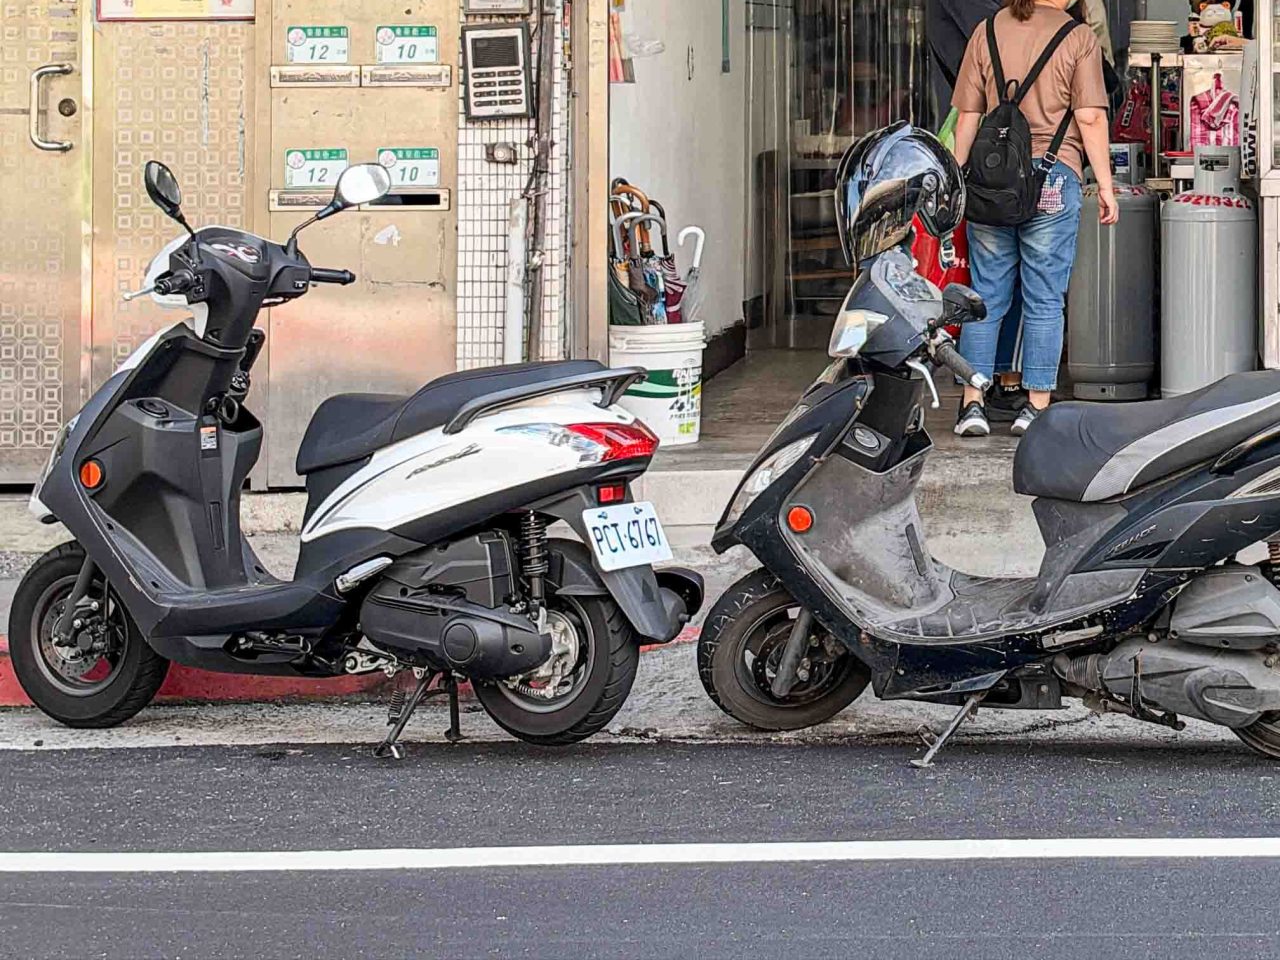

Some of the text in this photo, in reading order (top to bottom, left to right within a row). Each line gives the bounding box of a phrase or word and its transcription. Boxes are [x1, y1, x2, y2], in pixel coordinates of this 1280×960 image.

[309, 44, 330, 60] 12
[397, 43, 418, 59] 10
[308, 167, 329, 183] 12
[399, 166, 419, 182] 10
